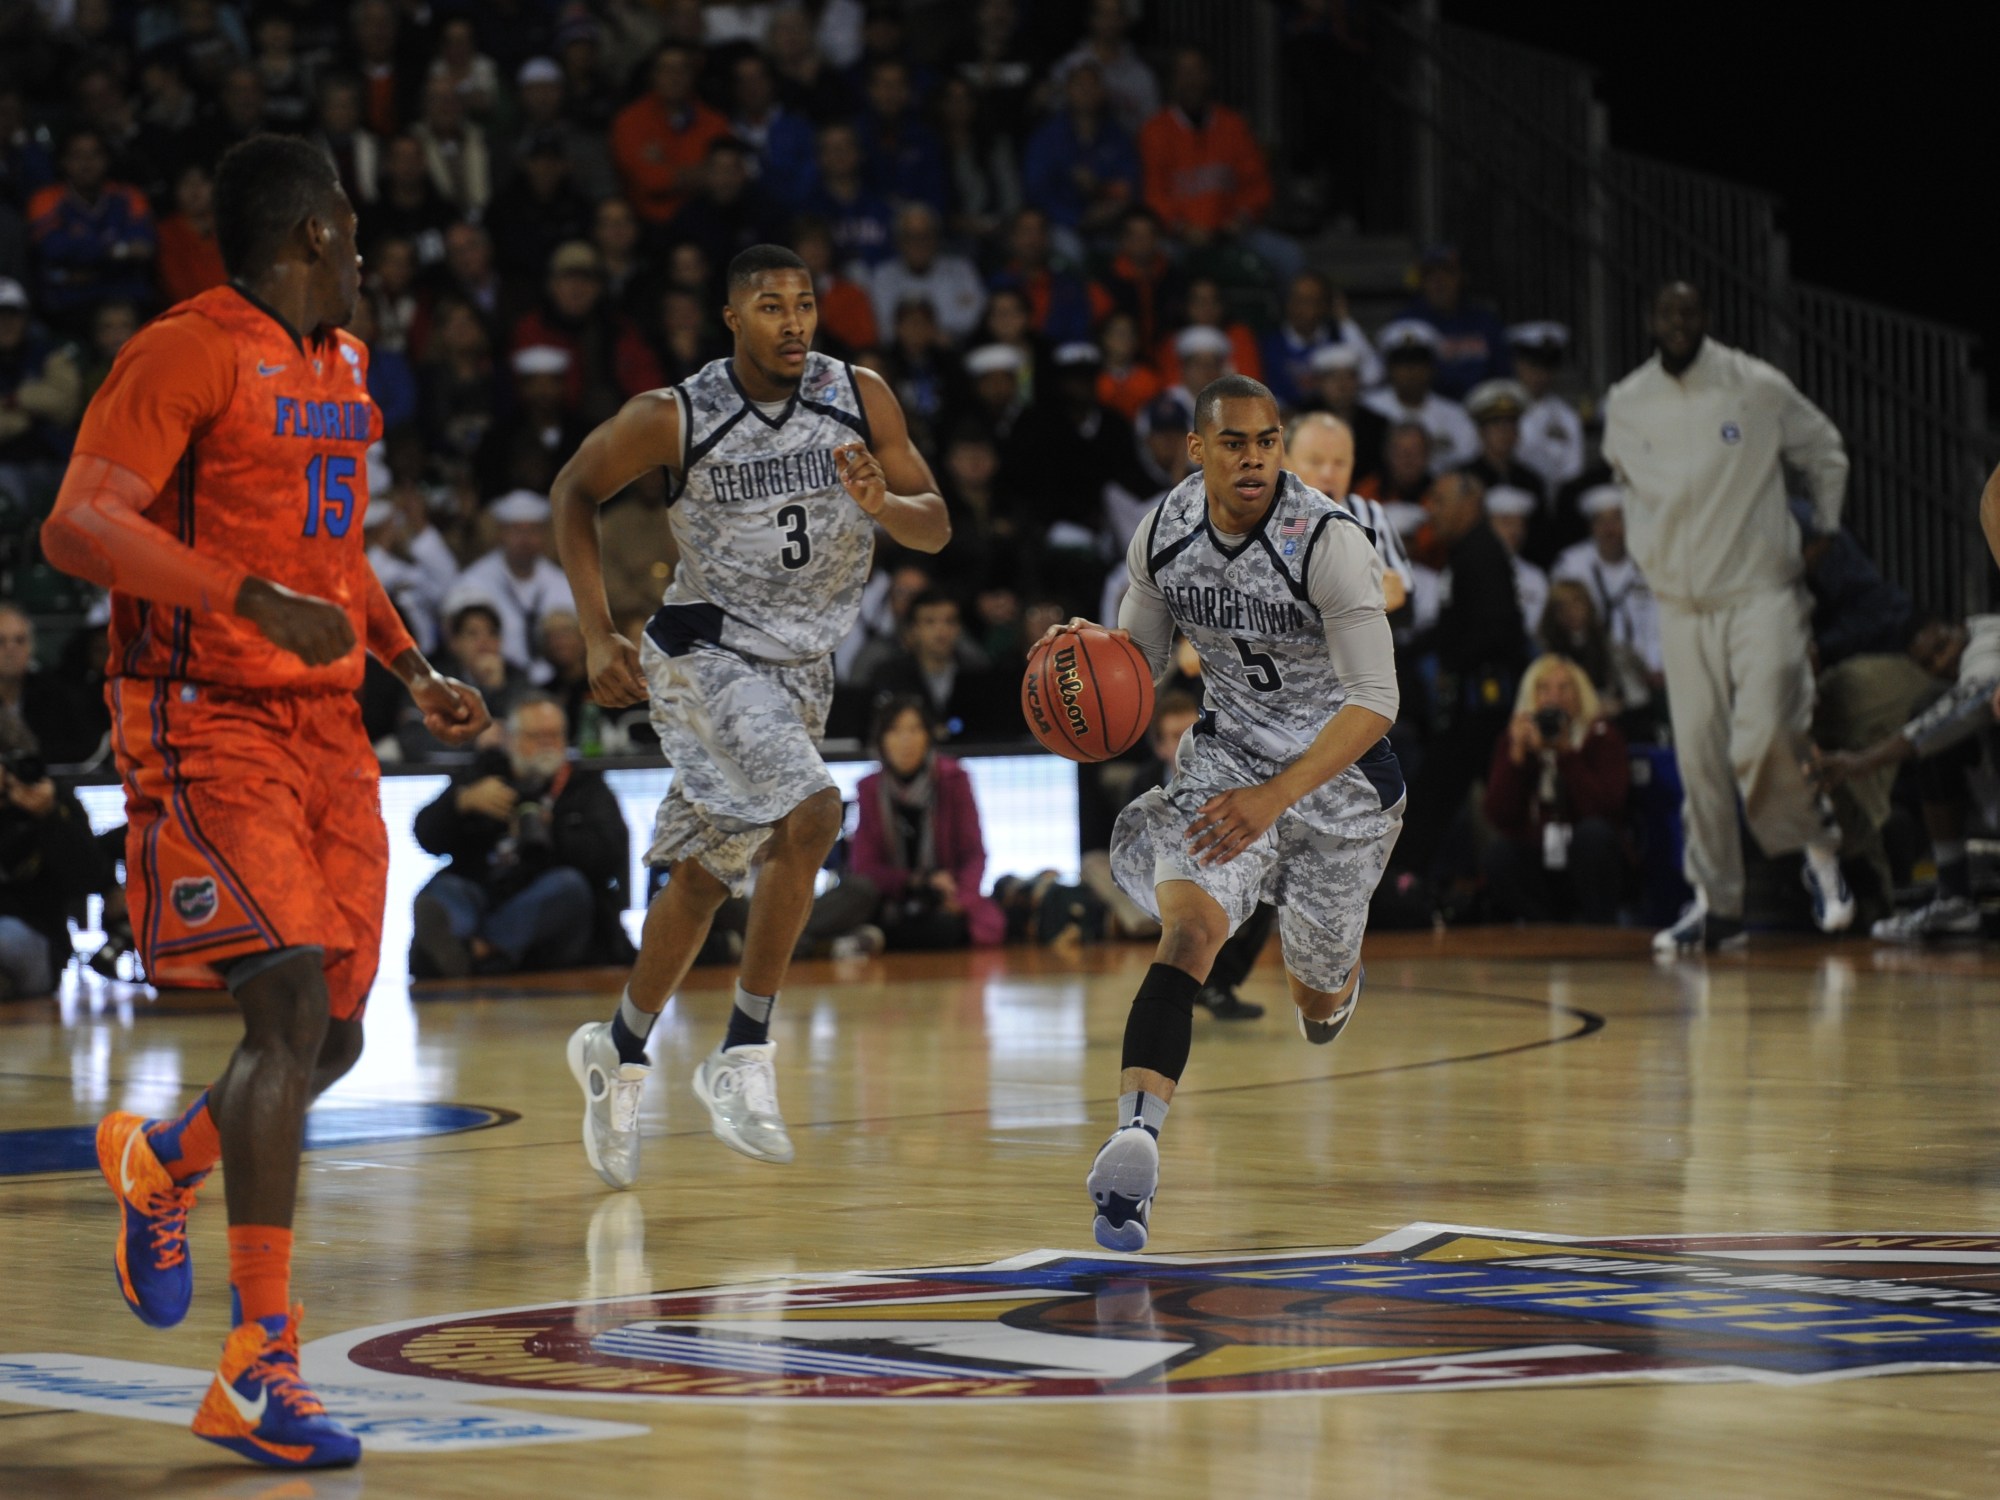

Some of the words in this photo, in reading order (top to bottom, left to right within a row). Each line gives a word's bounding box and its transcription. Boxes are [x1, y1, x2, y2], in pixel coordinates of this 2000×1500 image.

[274, 396, 371, 442] FLORID
[303, 453, 356, 538] 15
[710, 449, 840, 503] GEORGETOW
[776, 503, 812, 571] 3
[1163, 585, 1305, 635] GEORGETOWN
[1053, 645, 1089, 737] Wilson
[1230, 636, 1284, 693] 5
[1028, 672, 1051, 735] NCAA
[1210, 1263, 2000, 1345] CLASSIC
